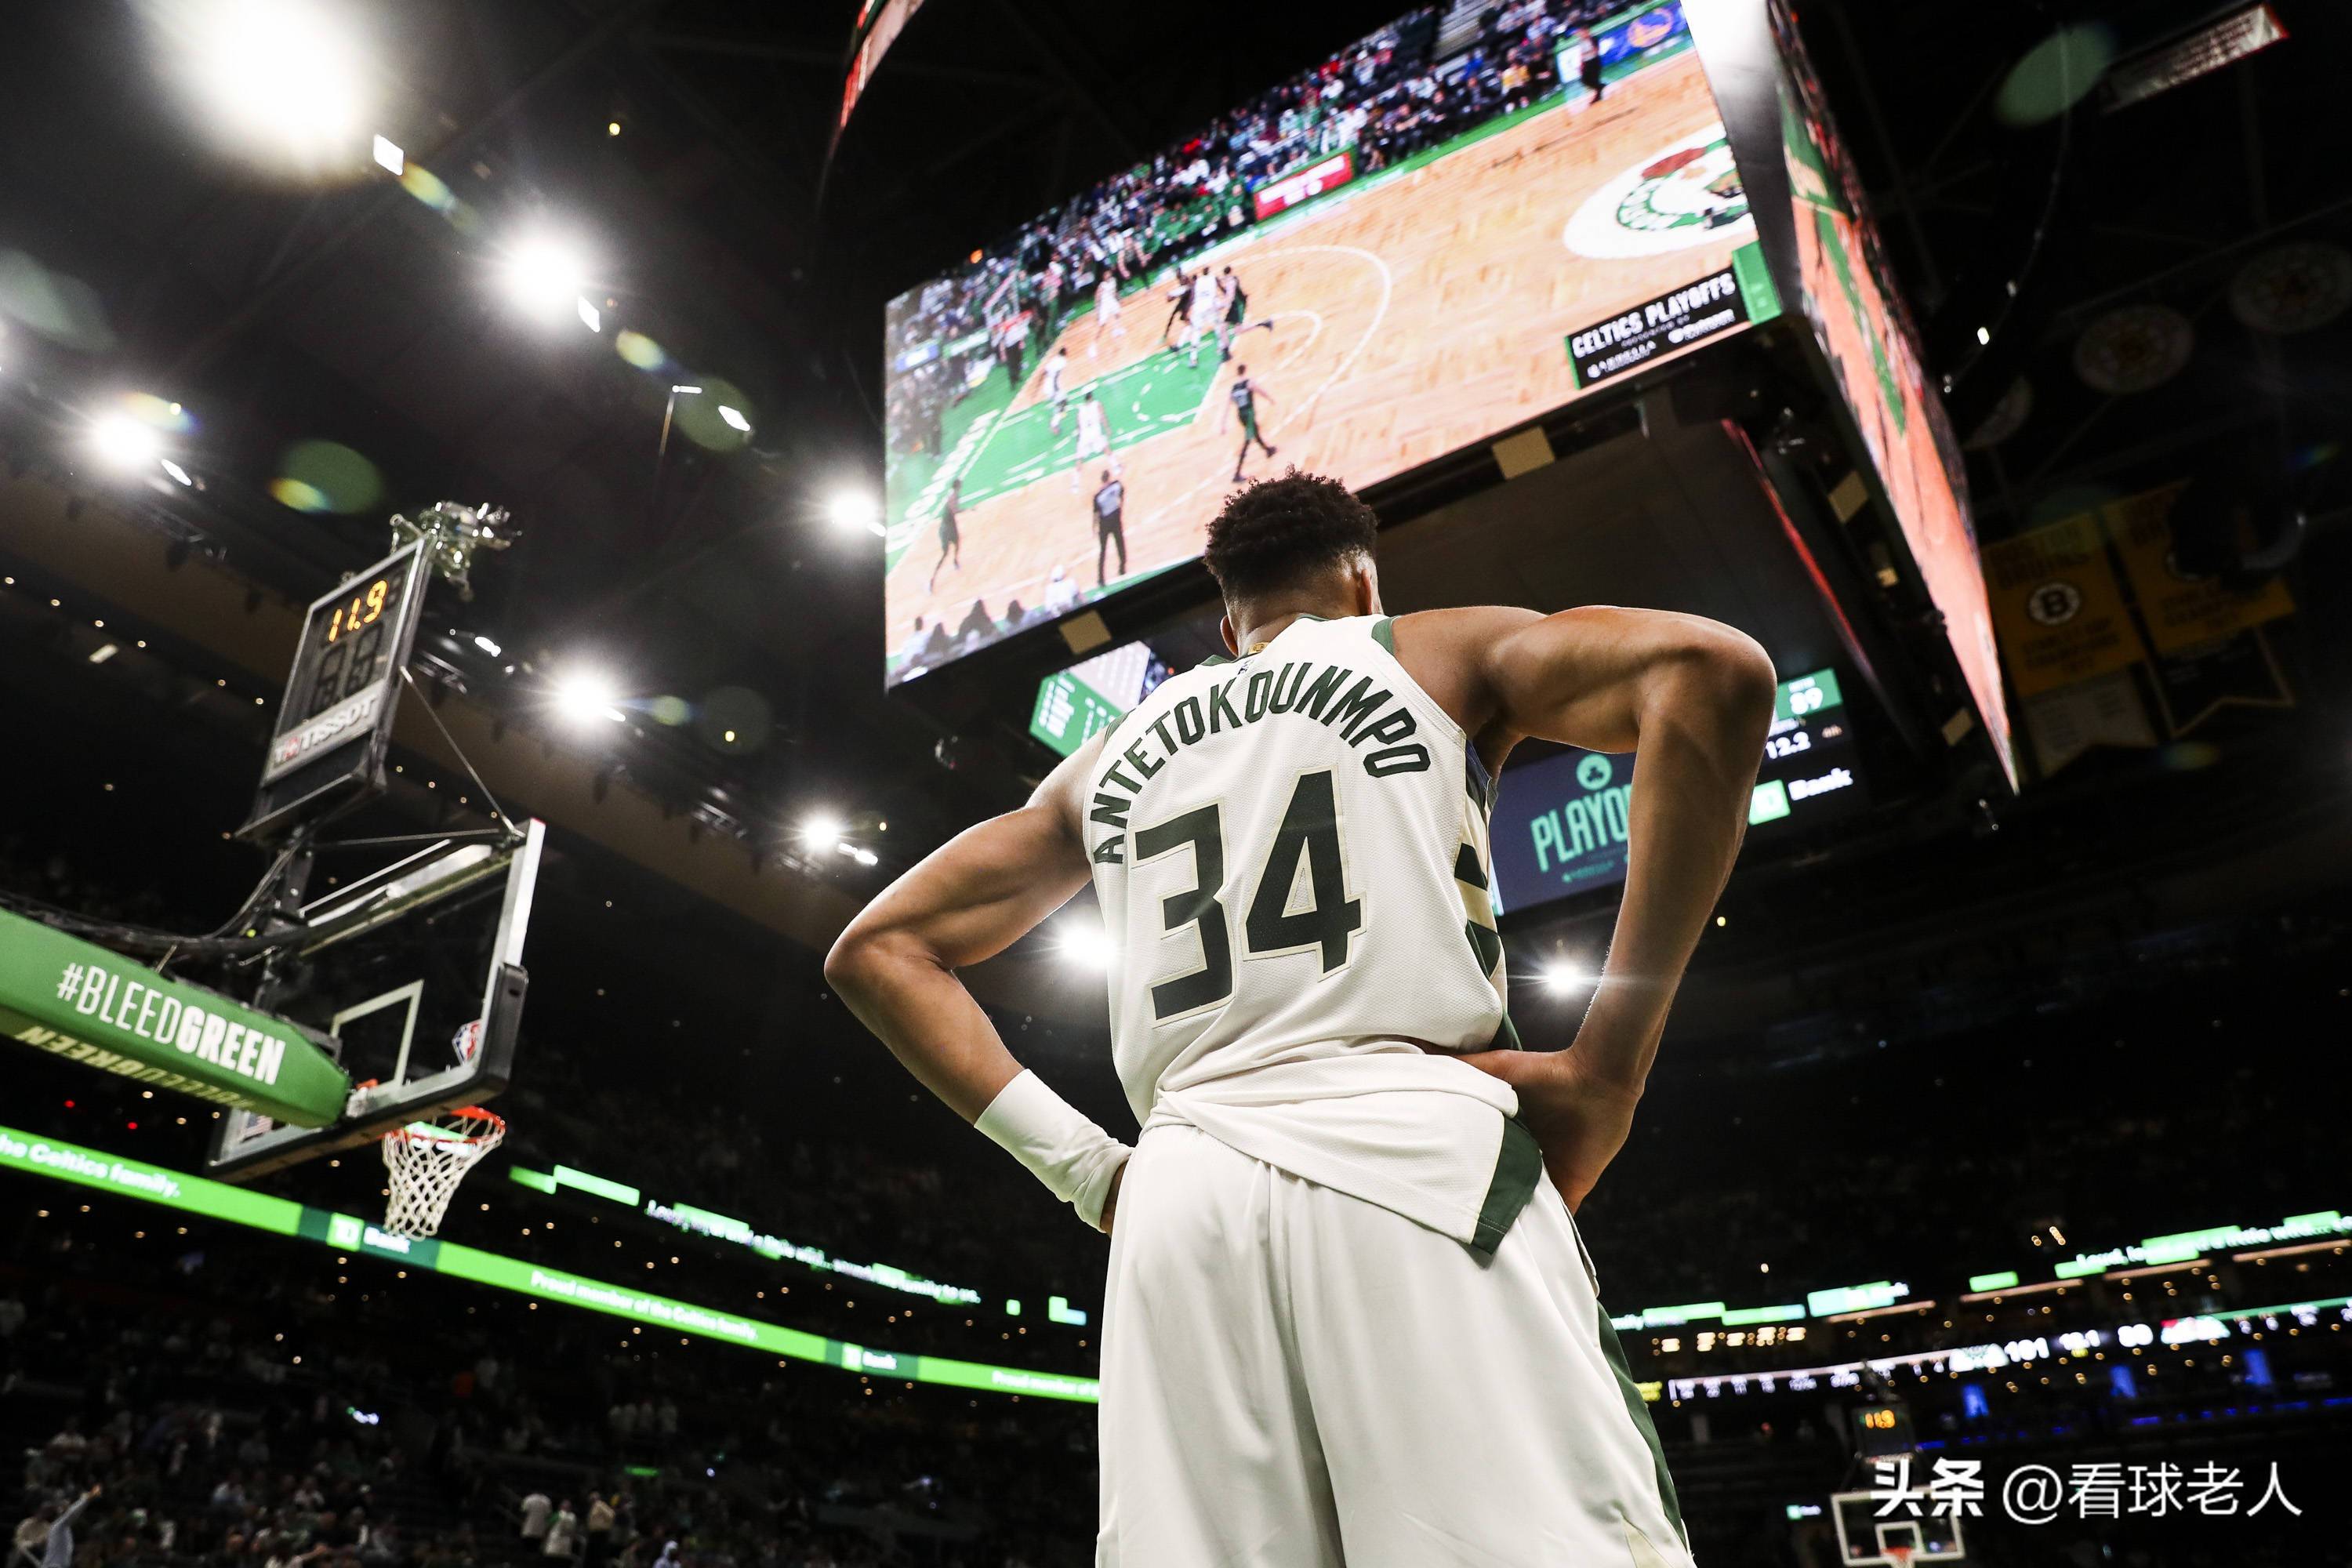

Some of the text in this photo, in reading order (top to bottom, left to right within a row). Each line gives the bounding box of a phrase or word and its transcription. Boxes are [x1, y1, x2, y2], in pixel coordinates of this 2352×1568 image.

[1572, 311, 1643, 358] CELTICS
[1645, 273, 1736, 328] PLAYOFFS
[328, 580, 388, 643] 11.9
[301, 693, 377, 751] TISSOT
[1090, 662, 1432, 864] ANTETOKOUNMPO
[1788, 768, 1853, 801] Bank
[1530, 784, 1632, 873] PLAYO
[1129, 765, 1367, 1025] 34
[57, 963, 286, 1085] #BLEEDGREEN
[29, 1143, 108, 1179] Celtics
[531, 1270, 577, 1296] Proud
